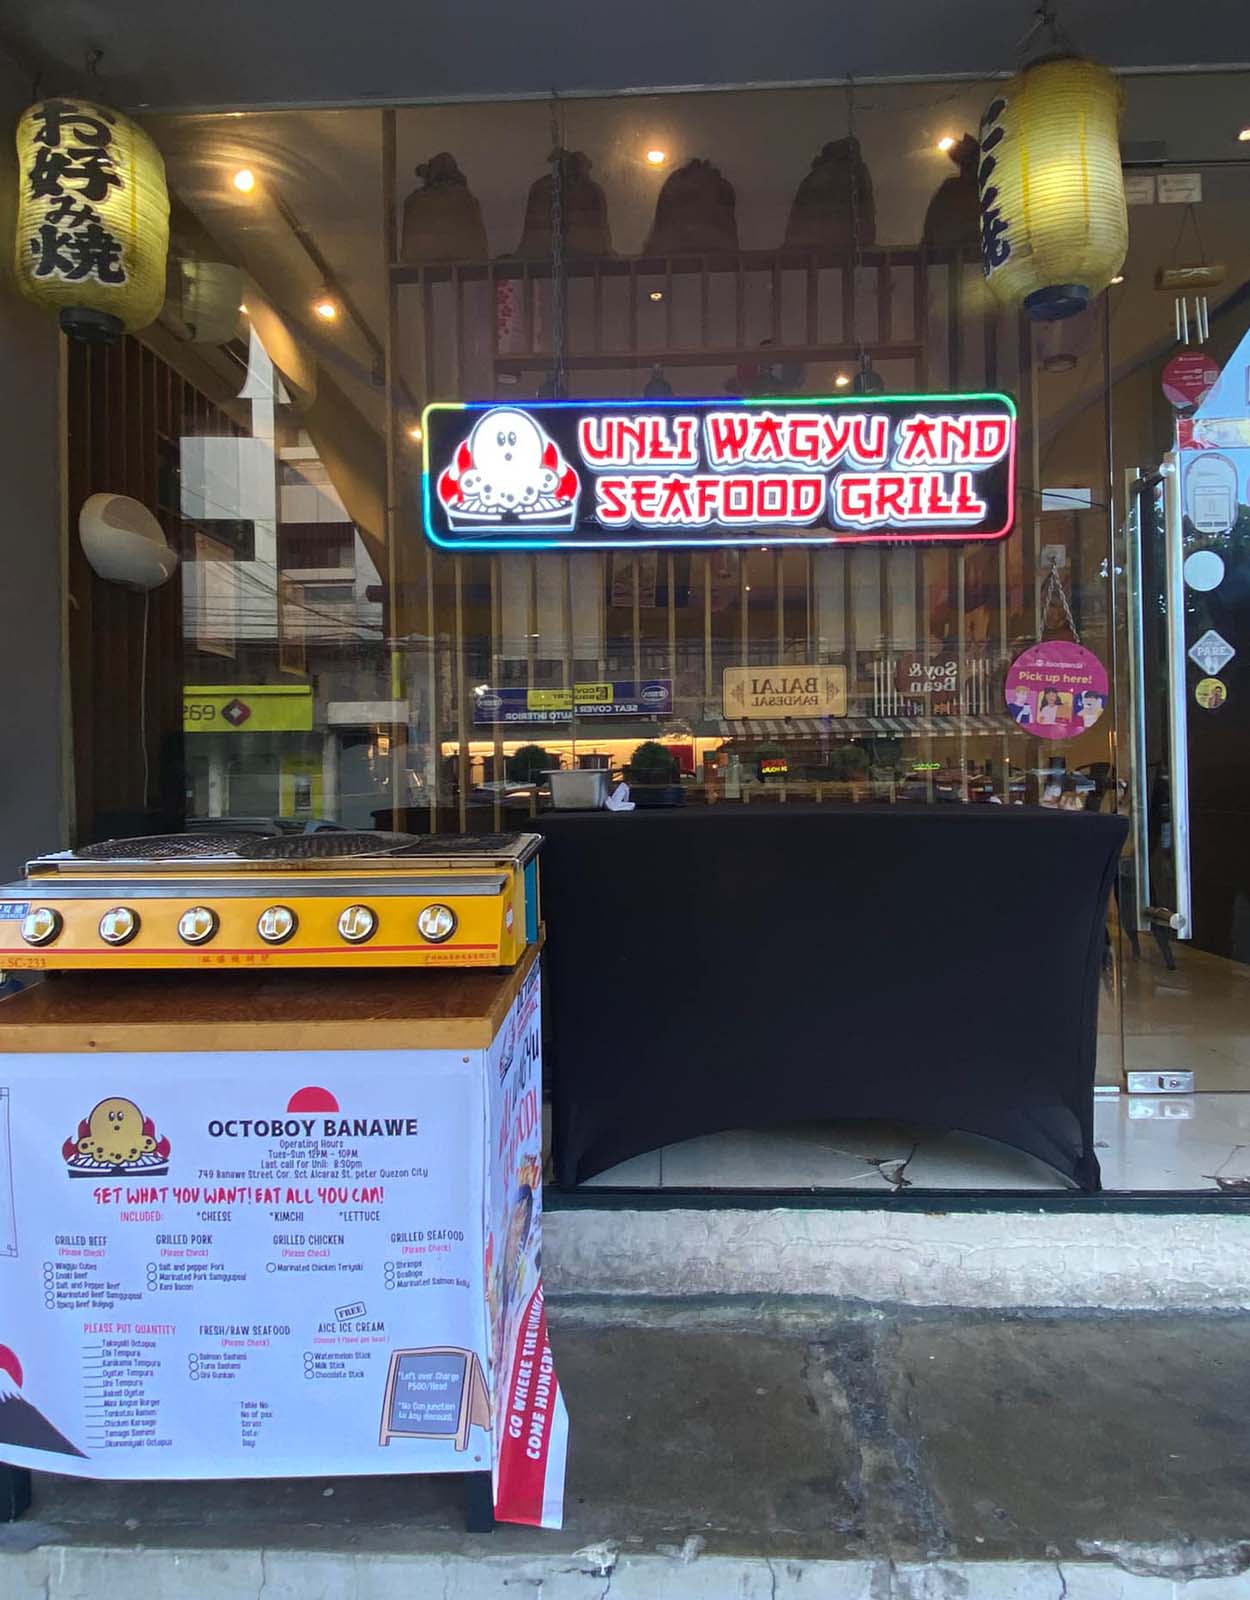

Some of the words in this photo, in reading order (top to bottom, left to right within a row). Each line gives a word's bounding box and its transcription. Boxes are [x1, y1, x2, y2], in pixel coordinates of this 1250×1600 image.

[580, 418, 698, 464] UNLI
[707, 414, 890, 465] WAGYU
[900, 416, 1009, 465] AND
[597, 476, 825, 523] SEAFOOD
[837, 474, 984, 523] GRILL
[1018, 671, 1042, 681] Pick
[1045, 674, 1061, 683] up
[1062, 673, 1093, 684] here!
[208, 1120, 315, 1137] OCTOBOY
[324, 1118, 418, 1136] BANAWE
[279, 1139, 319, 1150] Operating
[320, 1139, 344, 1149] Hours
[308, 1149, 328, 1159] 12PM
[338, 1149, 358, 1159] 10PM
[261, 1160, 277, 1169] Last
[281, 1160, 295, 1169] call
[297, 1160, 309, 1169] for
[216, 1170, 246, 1179] Banawe
[248, 1170, 274, 1179] Street
[310, 1169, 340, 1179] Alcaraz
[355, 1169, 377, 1180] peter
[379, 1168, 409, 1179] Quezon
[411, 1167, 429, 1178] City
[126, 1187, 169, 1204] WHAT
[172, 1187, 200, 1204] YOU
[203, 1187, 252, 1205] WANT!
[254, 1187, 282, 1204] EAT
[285, 1186, 314, 1204] ALL
[317, 1186, 349, 1204] YOU
[351, 1186, 384, 1205] CAN!
[54, 1235, 87, 1246] GRILLED
[88, 1235, 108, 1247] BEEF
[155, 1234, 188, 1245] GRILLED
[191, 1234, 214, 1245] PORK
[273, 1234, 306, 1246] GRILLED
[308, 1234, 345, 1246] CHICKEN
[390, 1231, 424, 1244] GRILLED
[426, 1229, 465, 1242] SEAFOOD
[338, 1304, 363, 1319] FREE
[83, 1323, 113, 1334] PLEASE
[116, 1323, 132, 1334] PUT
[135, 1323, 177, 1336] QUANTITY
[199, 1325, 250, 1336] FRESH/RAW
[252, 1325, 291, 1336] SEAFOOD
[339, 1322, 353, 1333] ICE
[355, 1321, 385, 1333] CREAM
[522, 1328, 539, 1358] THE
[512, 1359, 534, 1413] WHERE
[508, 1414, 524, 1439] GO
[526, 1411, 546, 1461] COME
